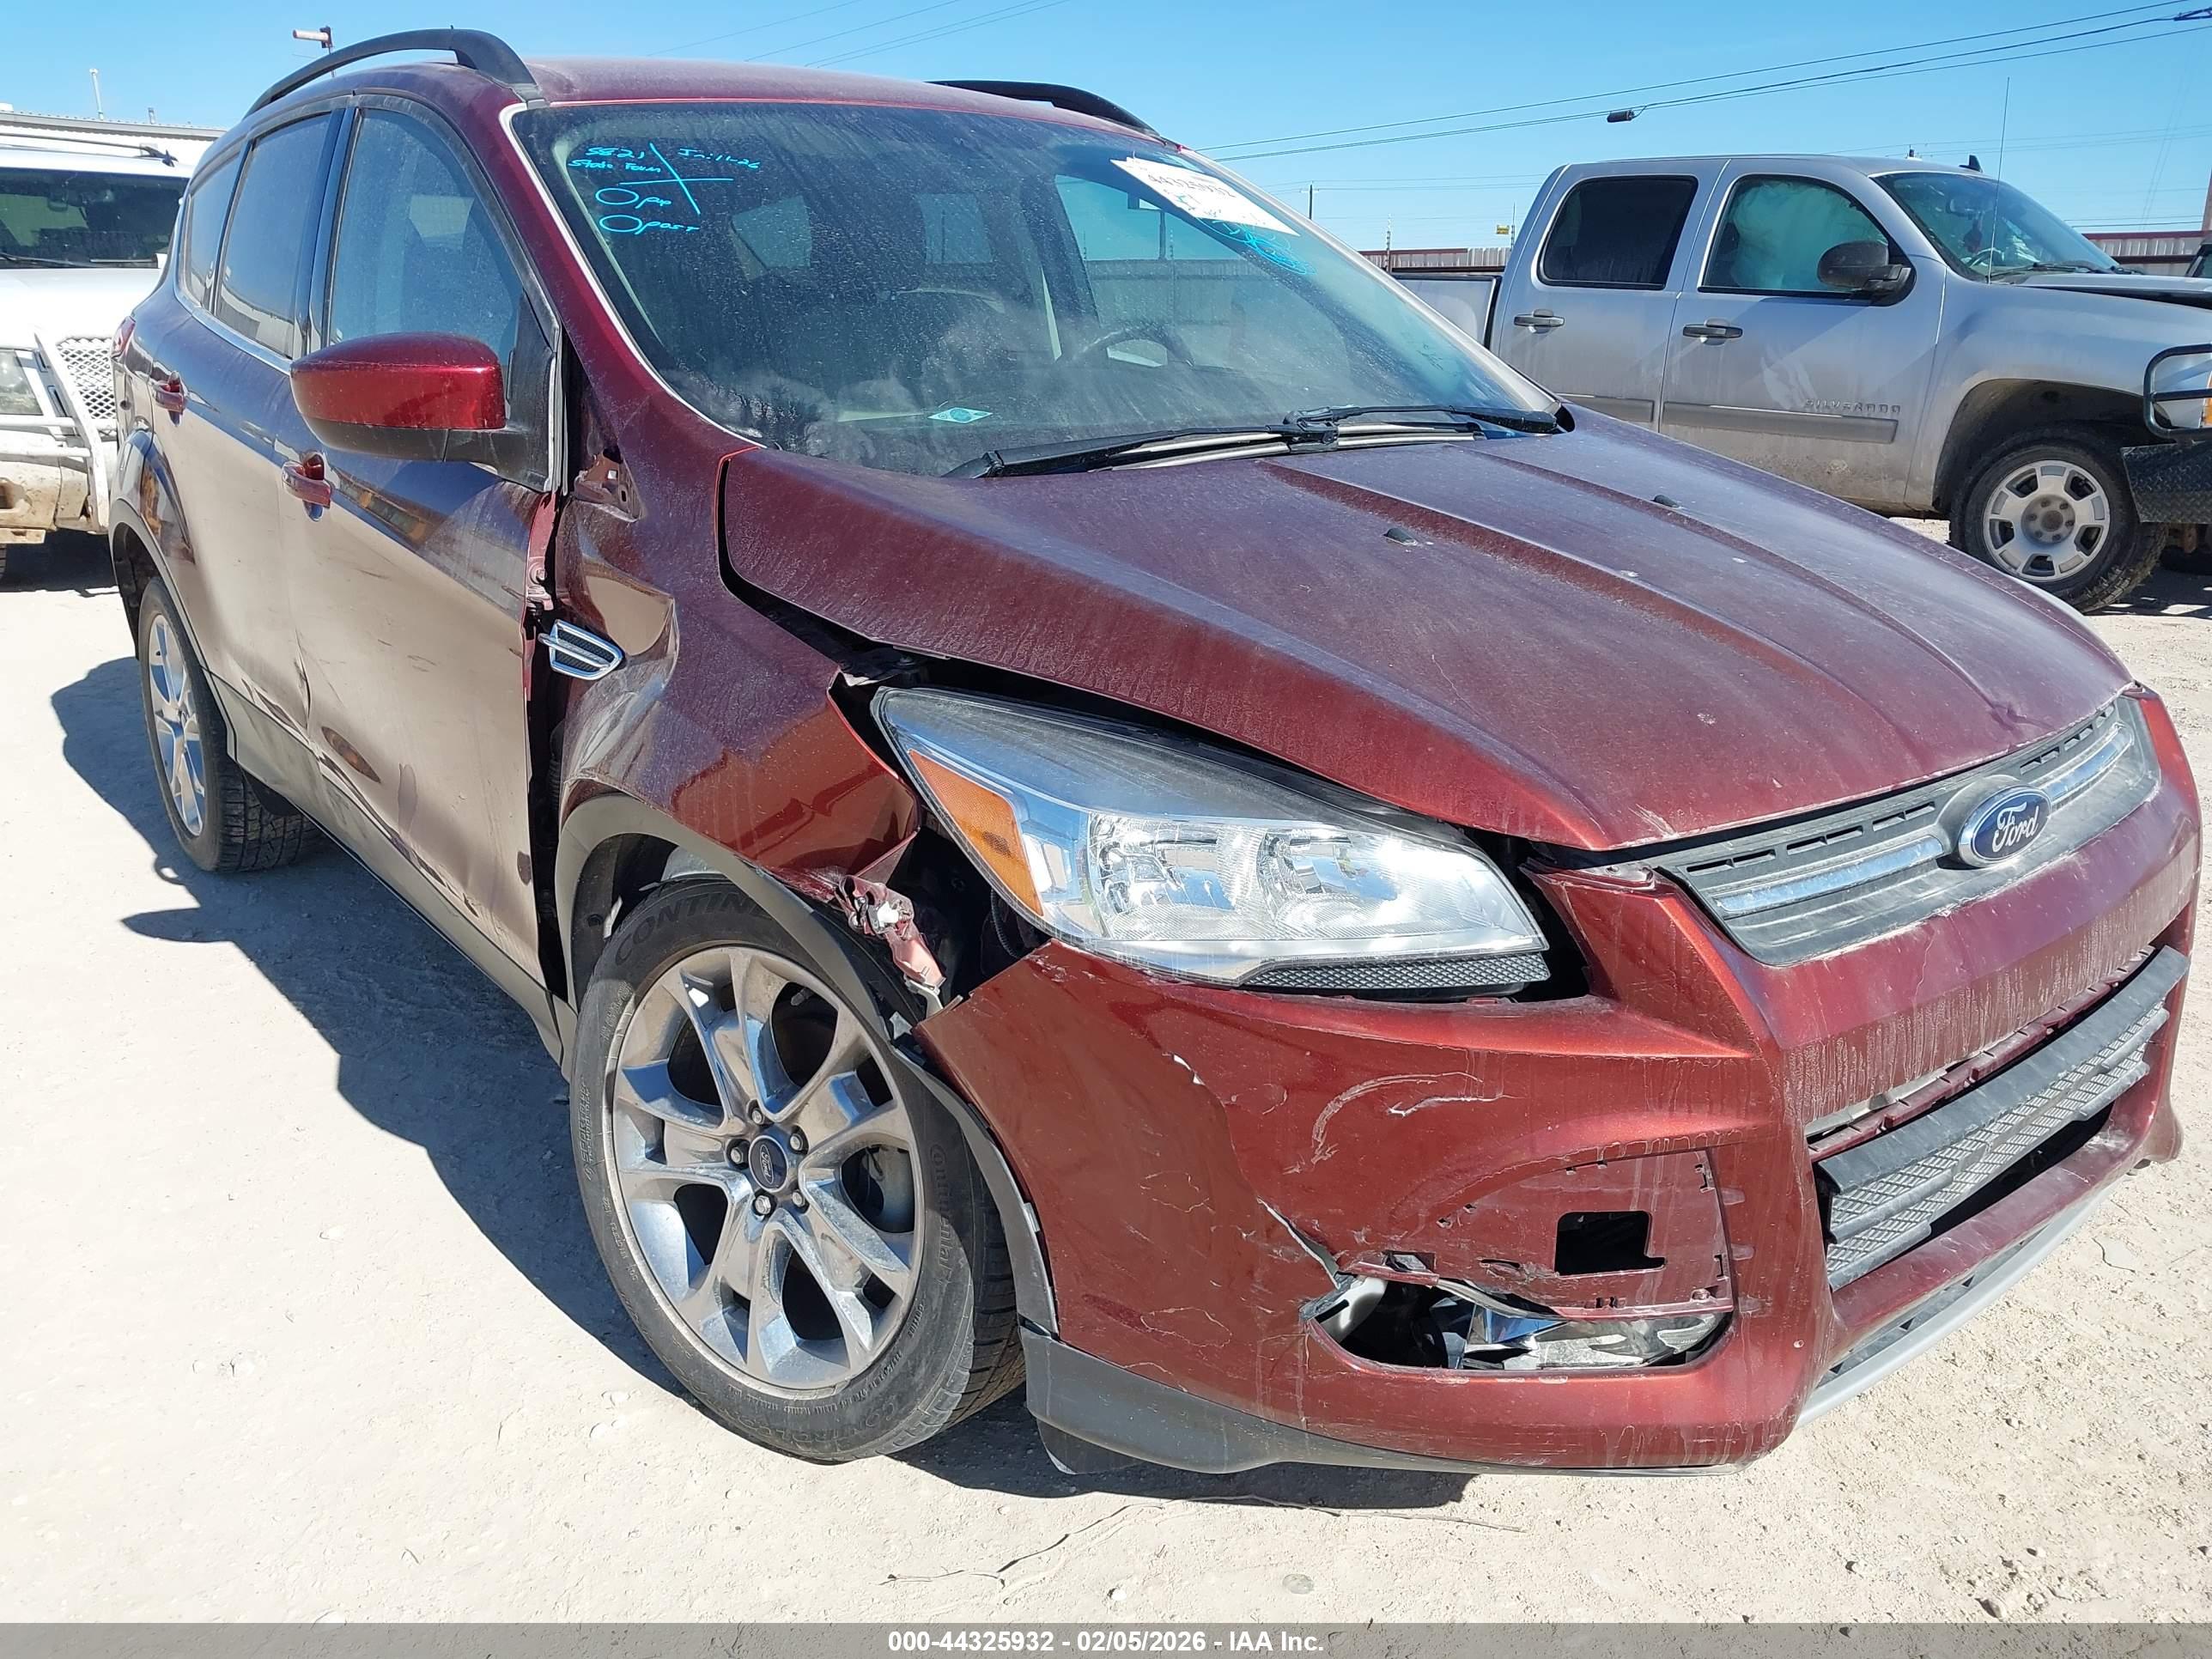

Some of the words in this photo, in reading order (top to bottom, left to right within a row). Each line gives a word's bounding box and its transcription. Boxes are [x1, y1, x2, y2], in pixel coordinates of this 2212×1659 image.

[1804, 398, 1901, 414] SILVERADO
[1992, 801, 2039, 853] Ford
[761, 1152, 772, 1178] Ford
